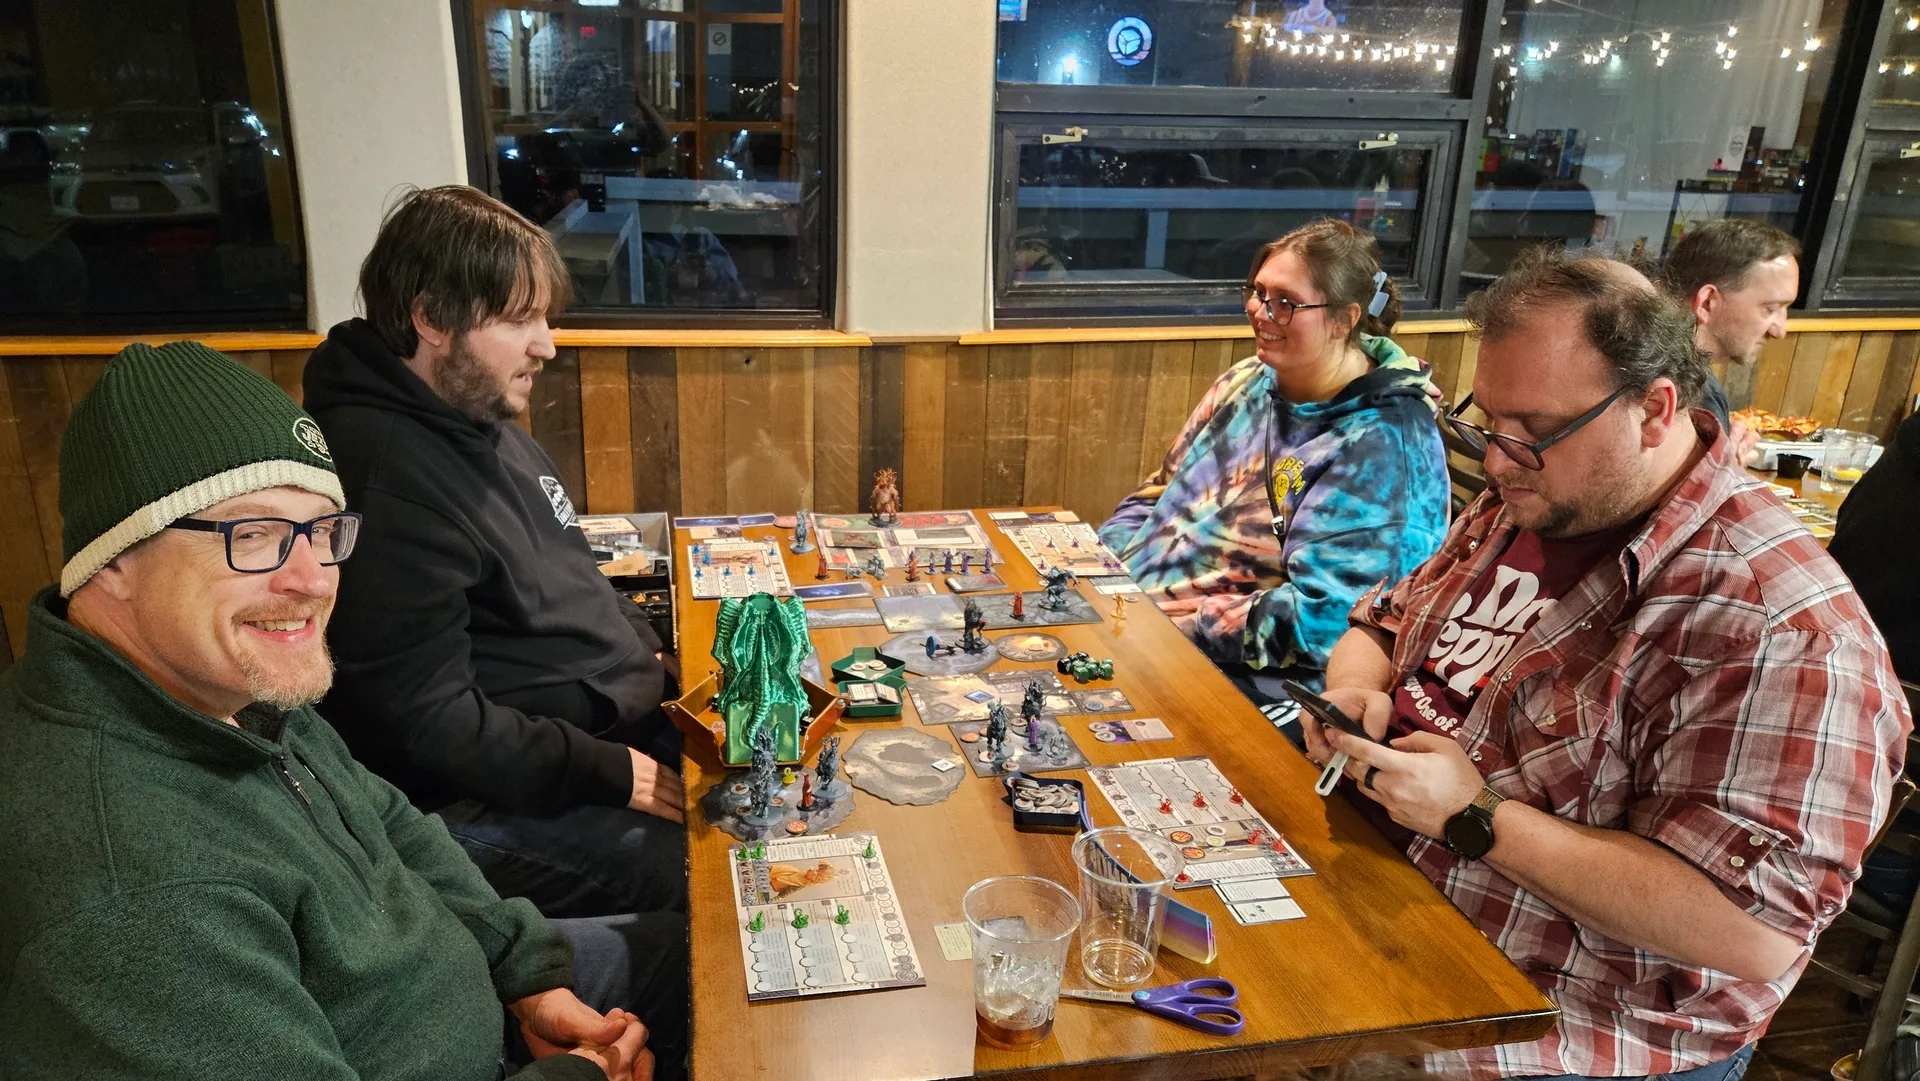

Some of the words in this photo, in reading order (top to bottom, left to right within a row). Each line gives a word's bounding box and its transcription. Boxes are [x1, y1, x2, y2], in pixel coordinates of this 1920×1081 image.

[1462, 565, 1559, 633] Dr
[1428, 592, 1516, 698] epp
[1415, 696, 1437, 721] One
[1434, 715, 1458, 732] of
